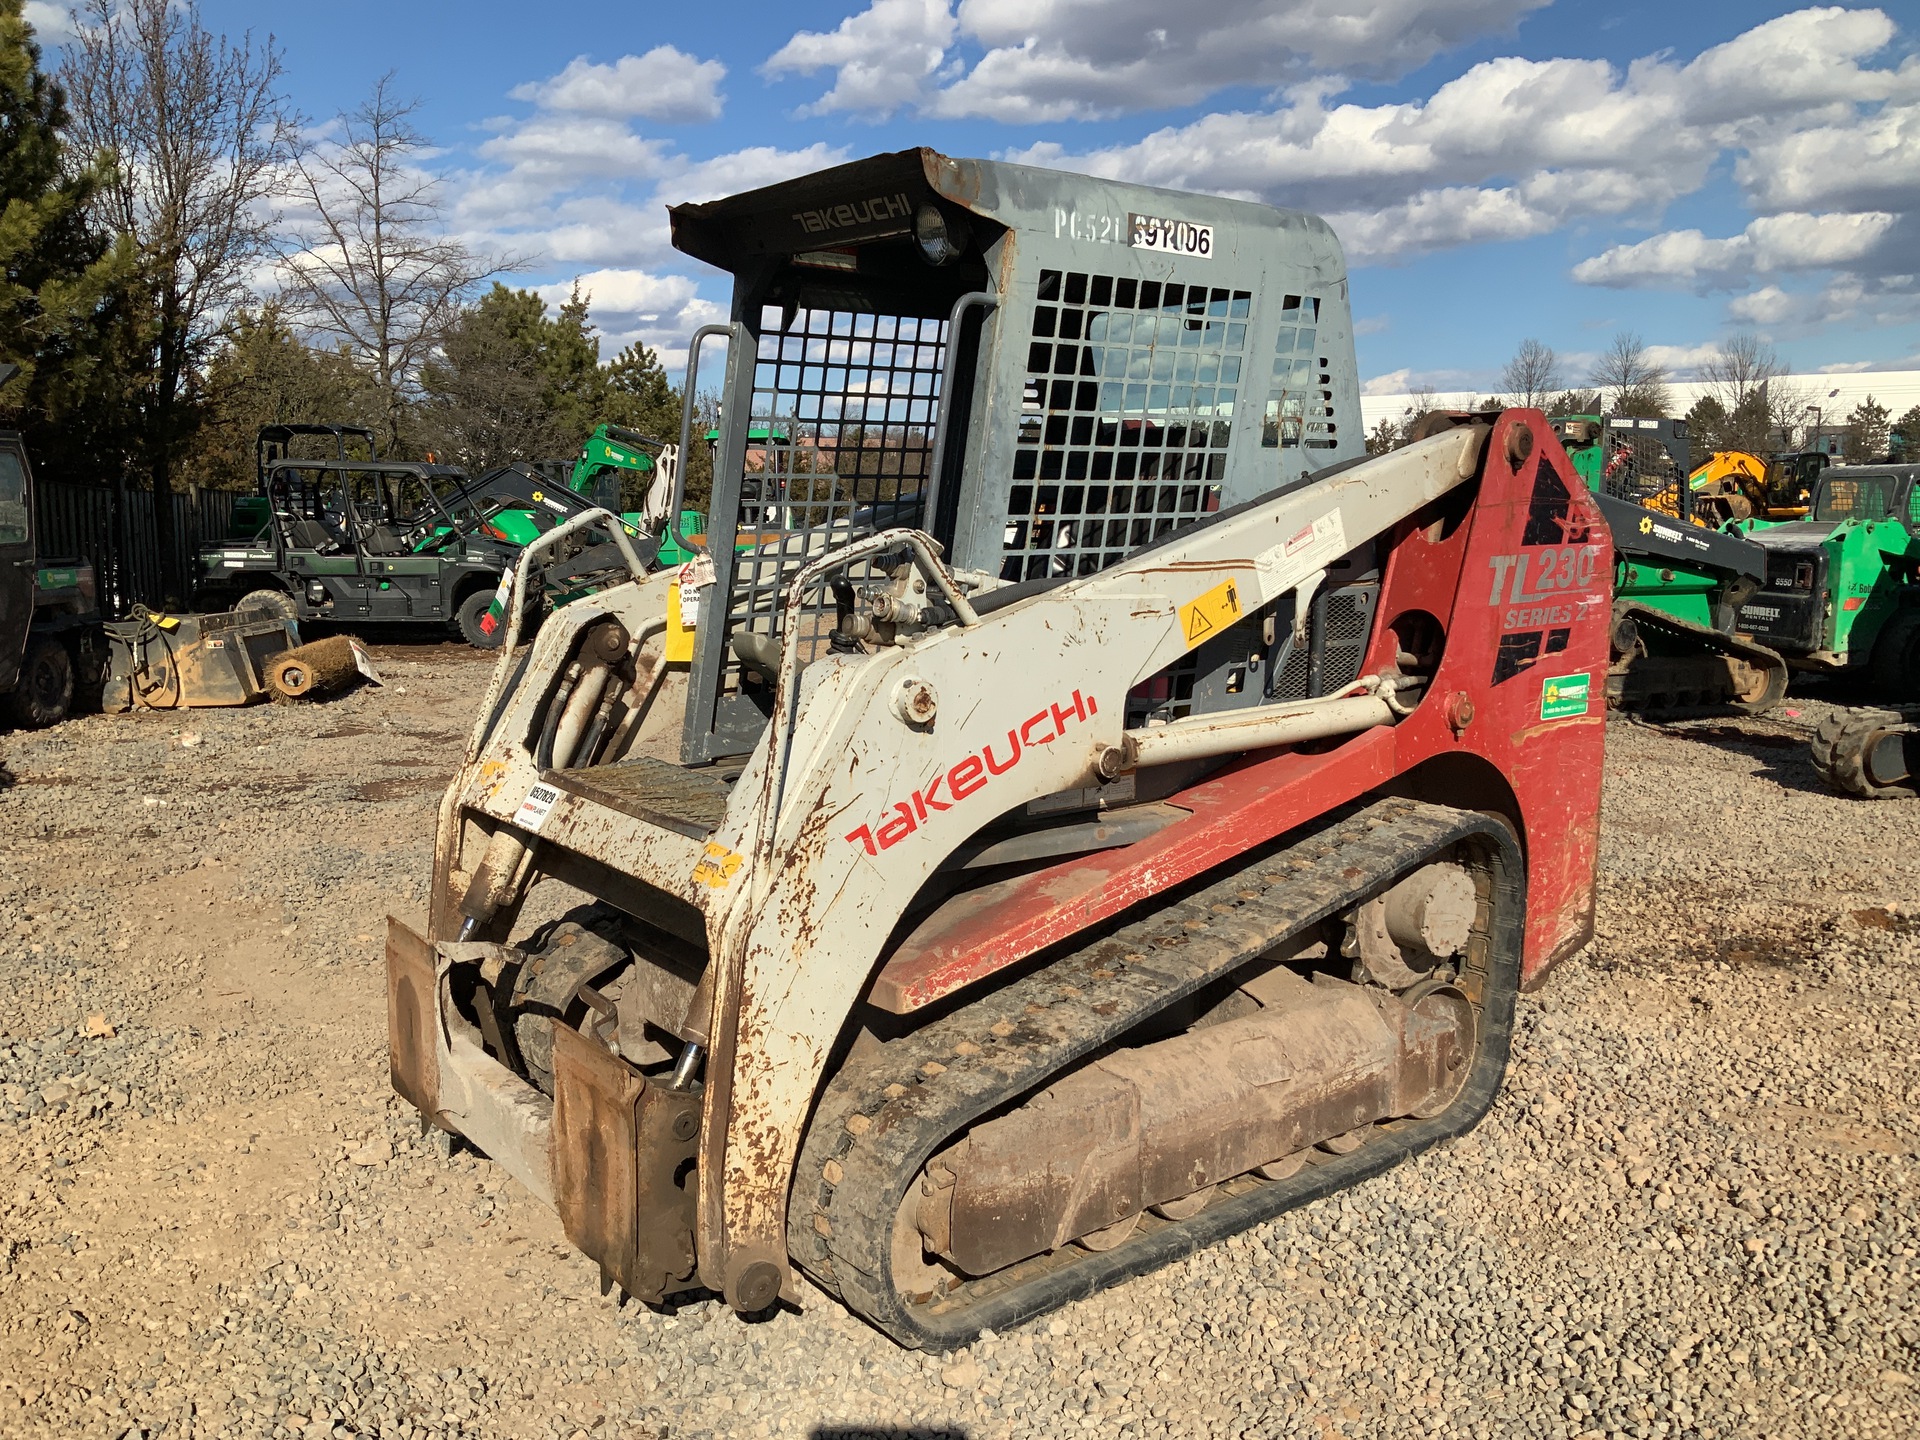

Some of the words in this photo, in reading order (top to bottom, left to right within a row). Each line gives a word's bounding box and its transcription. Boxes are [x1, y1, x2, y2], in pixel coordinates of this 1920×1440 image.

[792, 193, 912, 233] TAKEUCHI
[1652, 523, 1684, 542] SUNBELT
[1775, 577, 1793, 587] S550
[1503, 605, 1572, 630] SERIES
[1575, 603, 1589, 622] 2
[1740, 605, 1781, 618] SUNBELT
